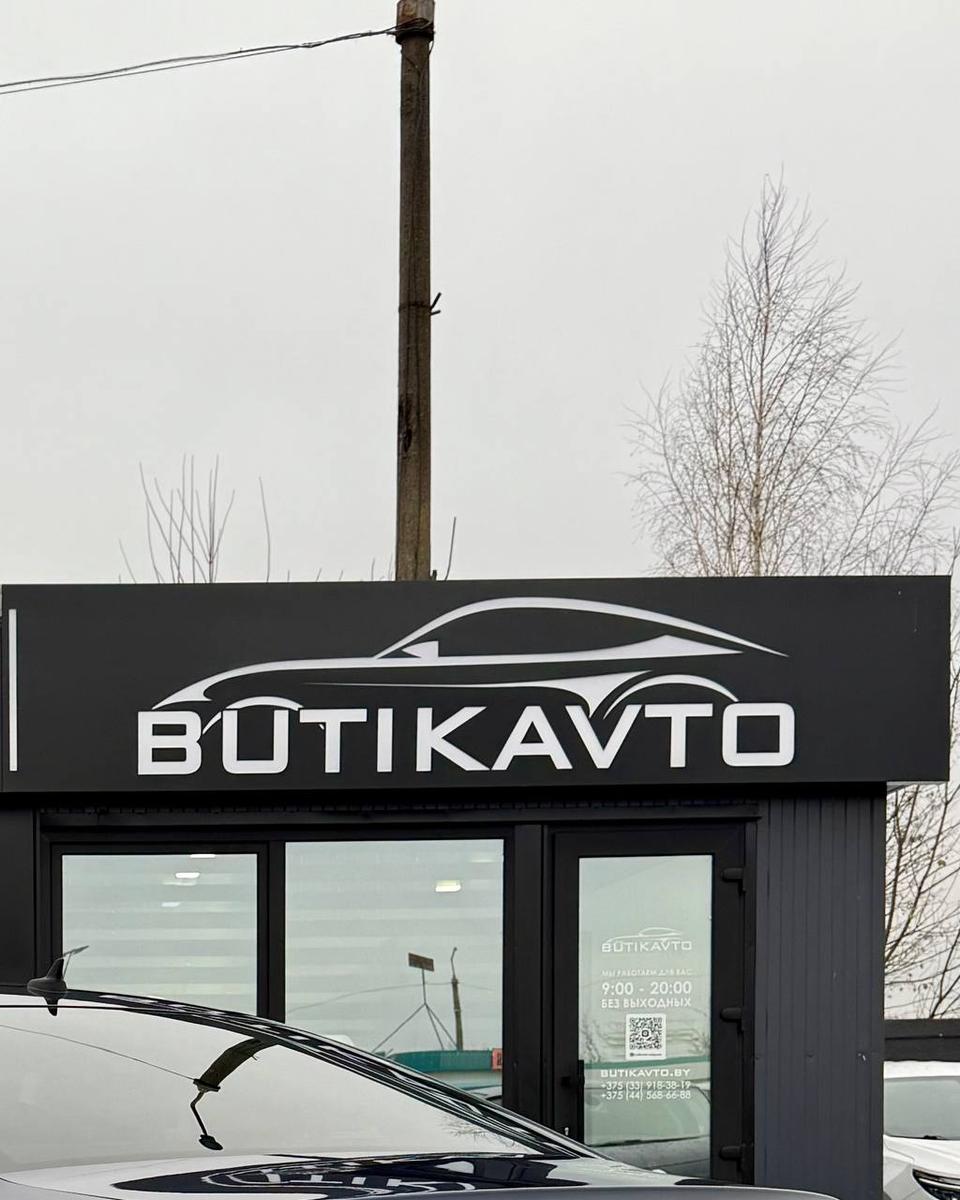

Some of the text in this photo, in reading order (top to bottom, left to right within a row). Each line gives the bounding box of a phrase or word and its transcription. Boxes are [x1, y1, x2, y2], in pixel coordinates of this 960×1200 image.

[137, 702, 795, 775] BUTIKAVTO
[601, 940, 692, 953] BUTIKAVTO
[601, 982, 634, 996] 9:00
[650, 981, 692, 995] 20:00
[601, 997, 692, 1009] БЕЗ ВЫХОДНЫХ
[600, 1068, 691, 1078] BUTIKAVTO.BY
